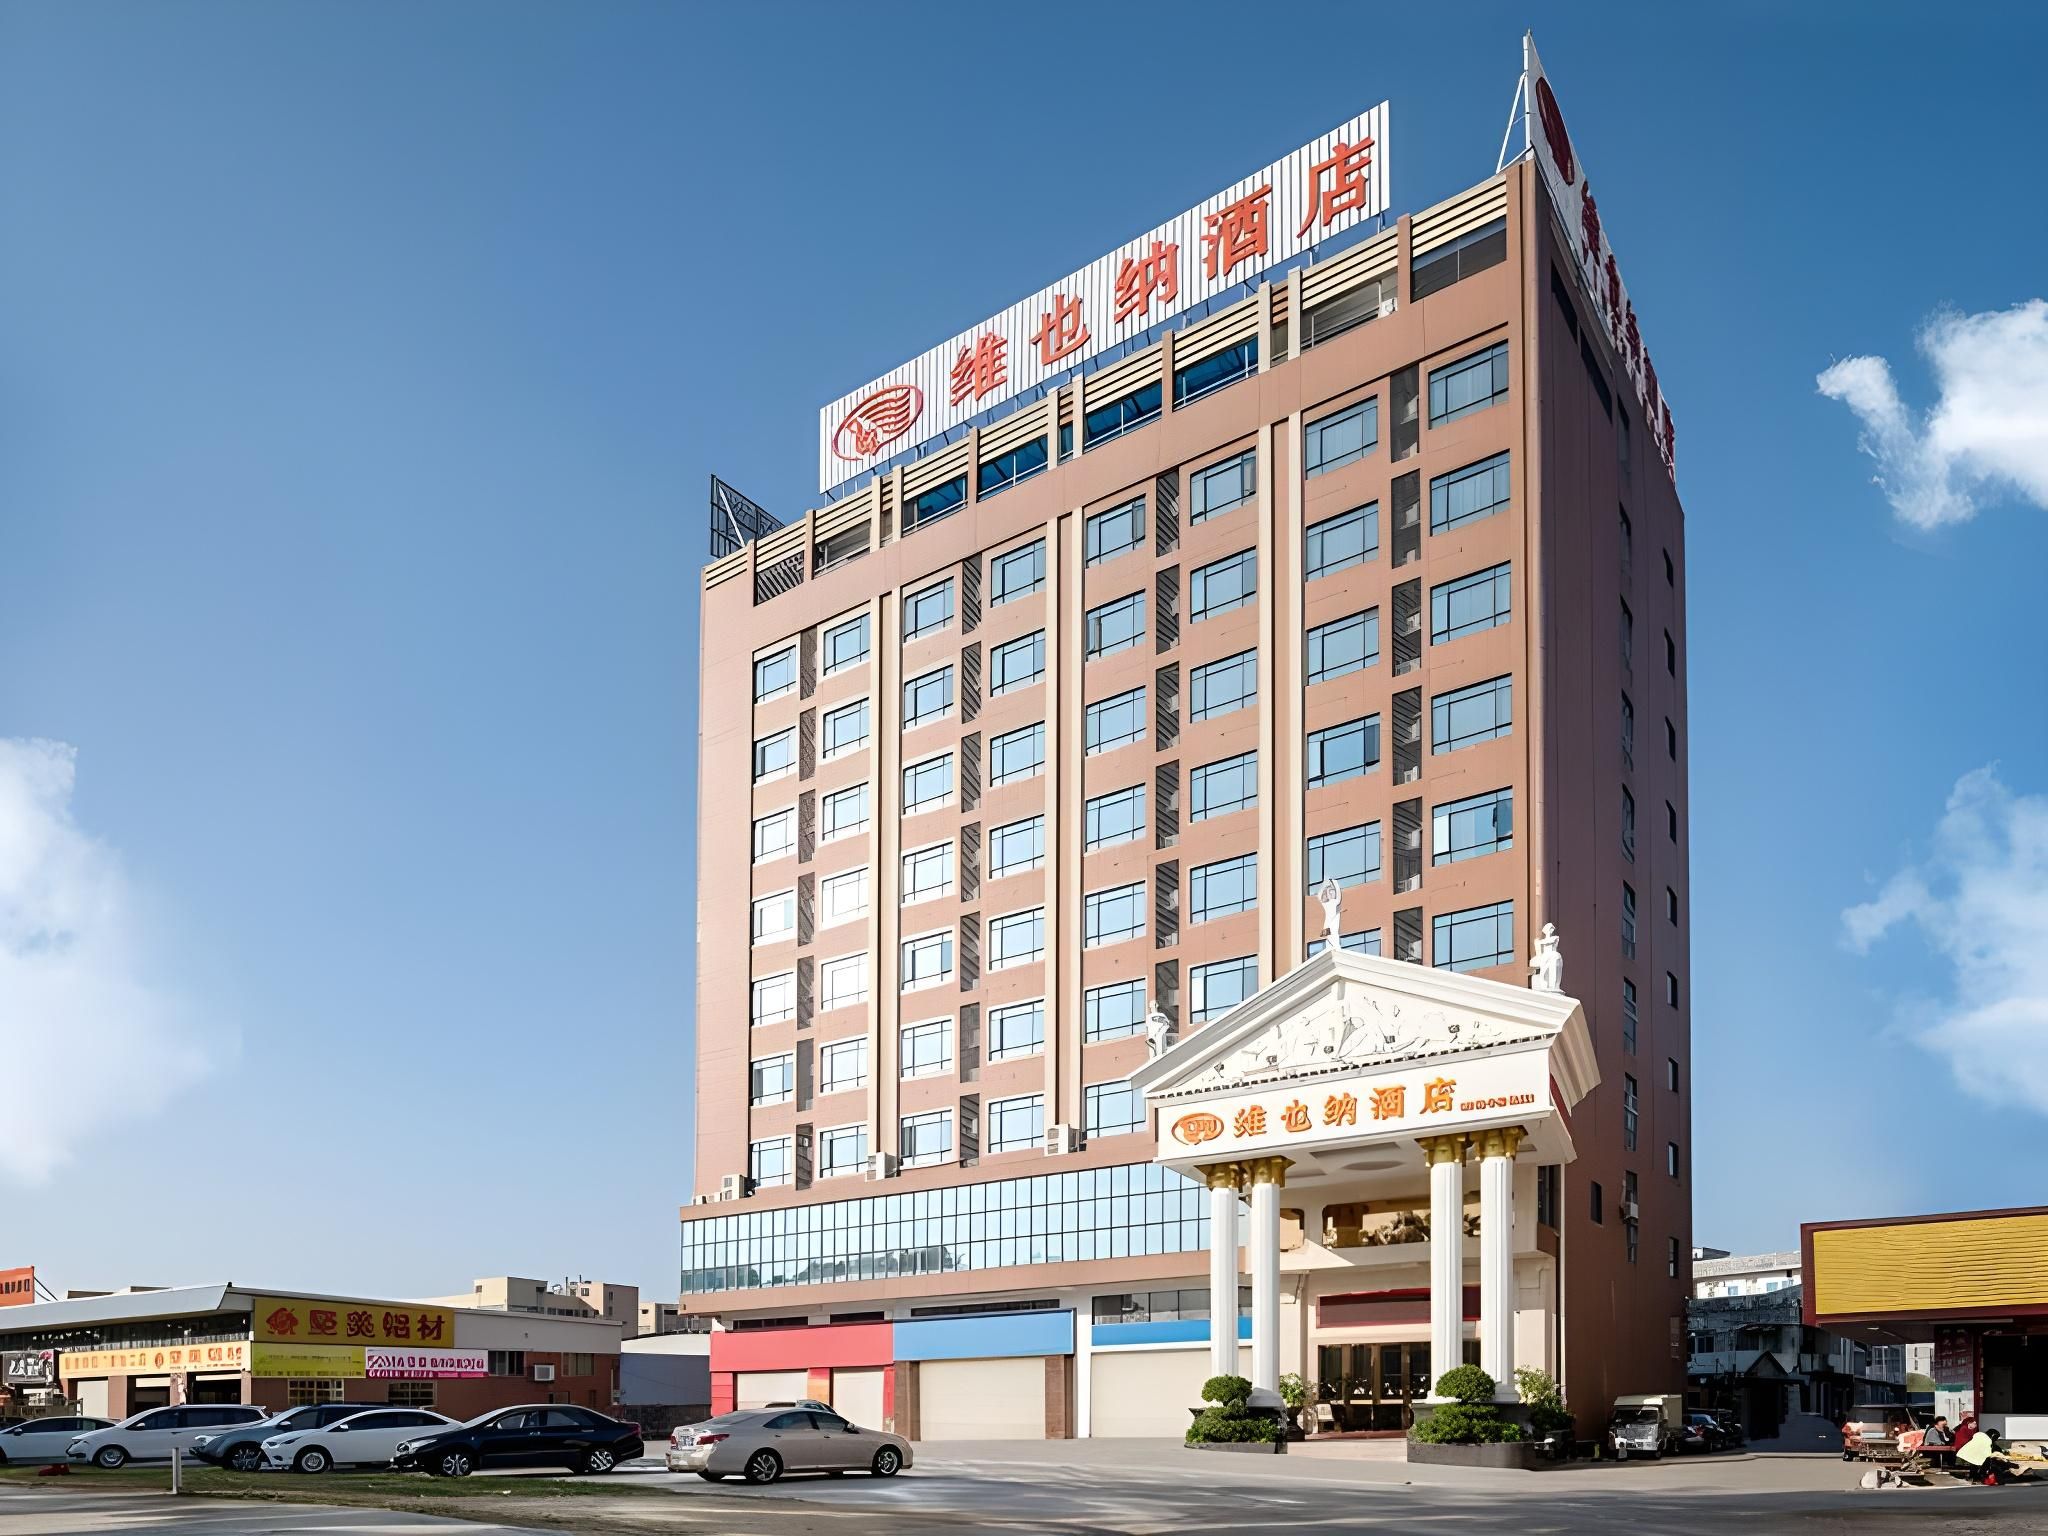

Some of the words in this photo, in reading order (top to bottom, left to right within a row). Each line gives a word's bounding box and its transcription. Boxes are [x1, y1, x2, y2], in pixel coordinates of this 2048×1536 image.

[950, 136, 1375, 407] 维也纳酒店
[1233, 1077, 1456, 1138] 维也纳酒店
